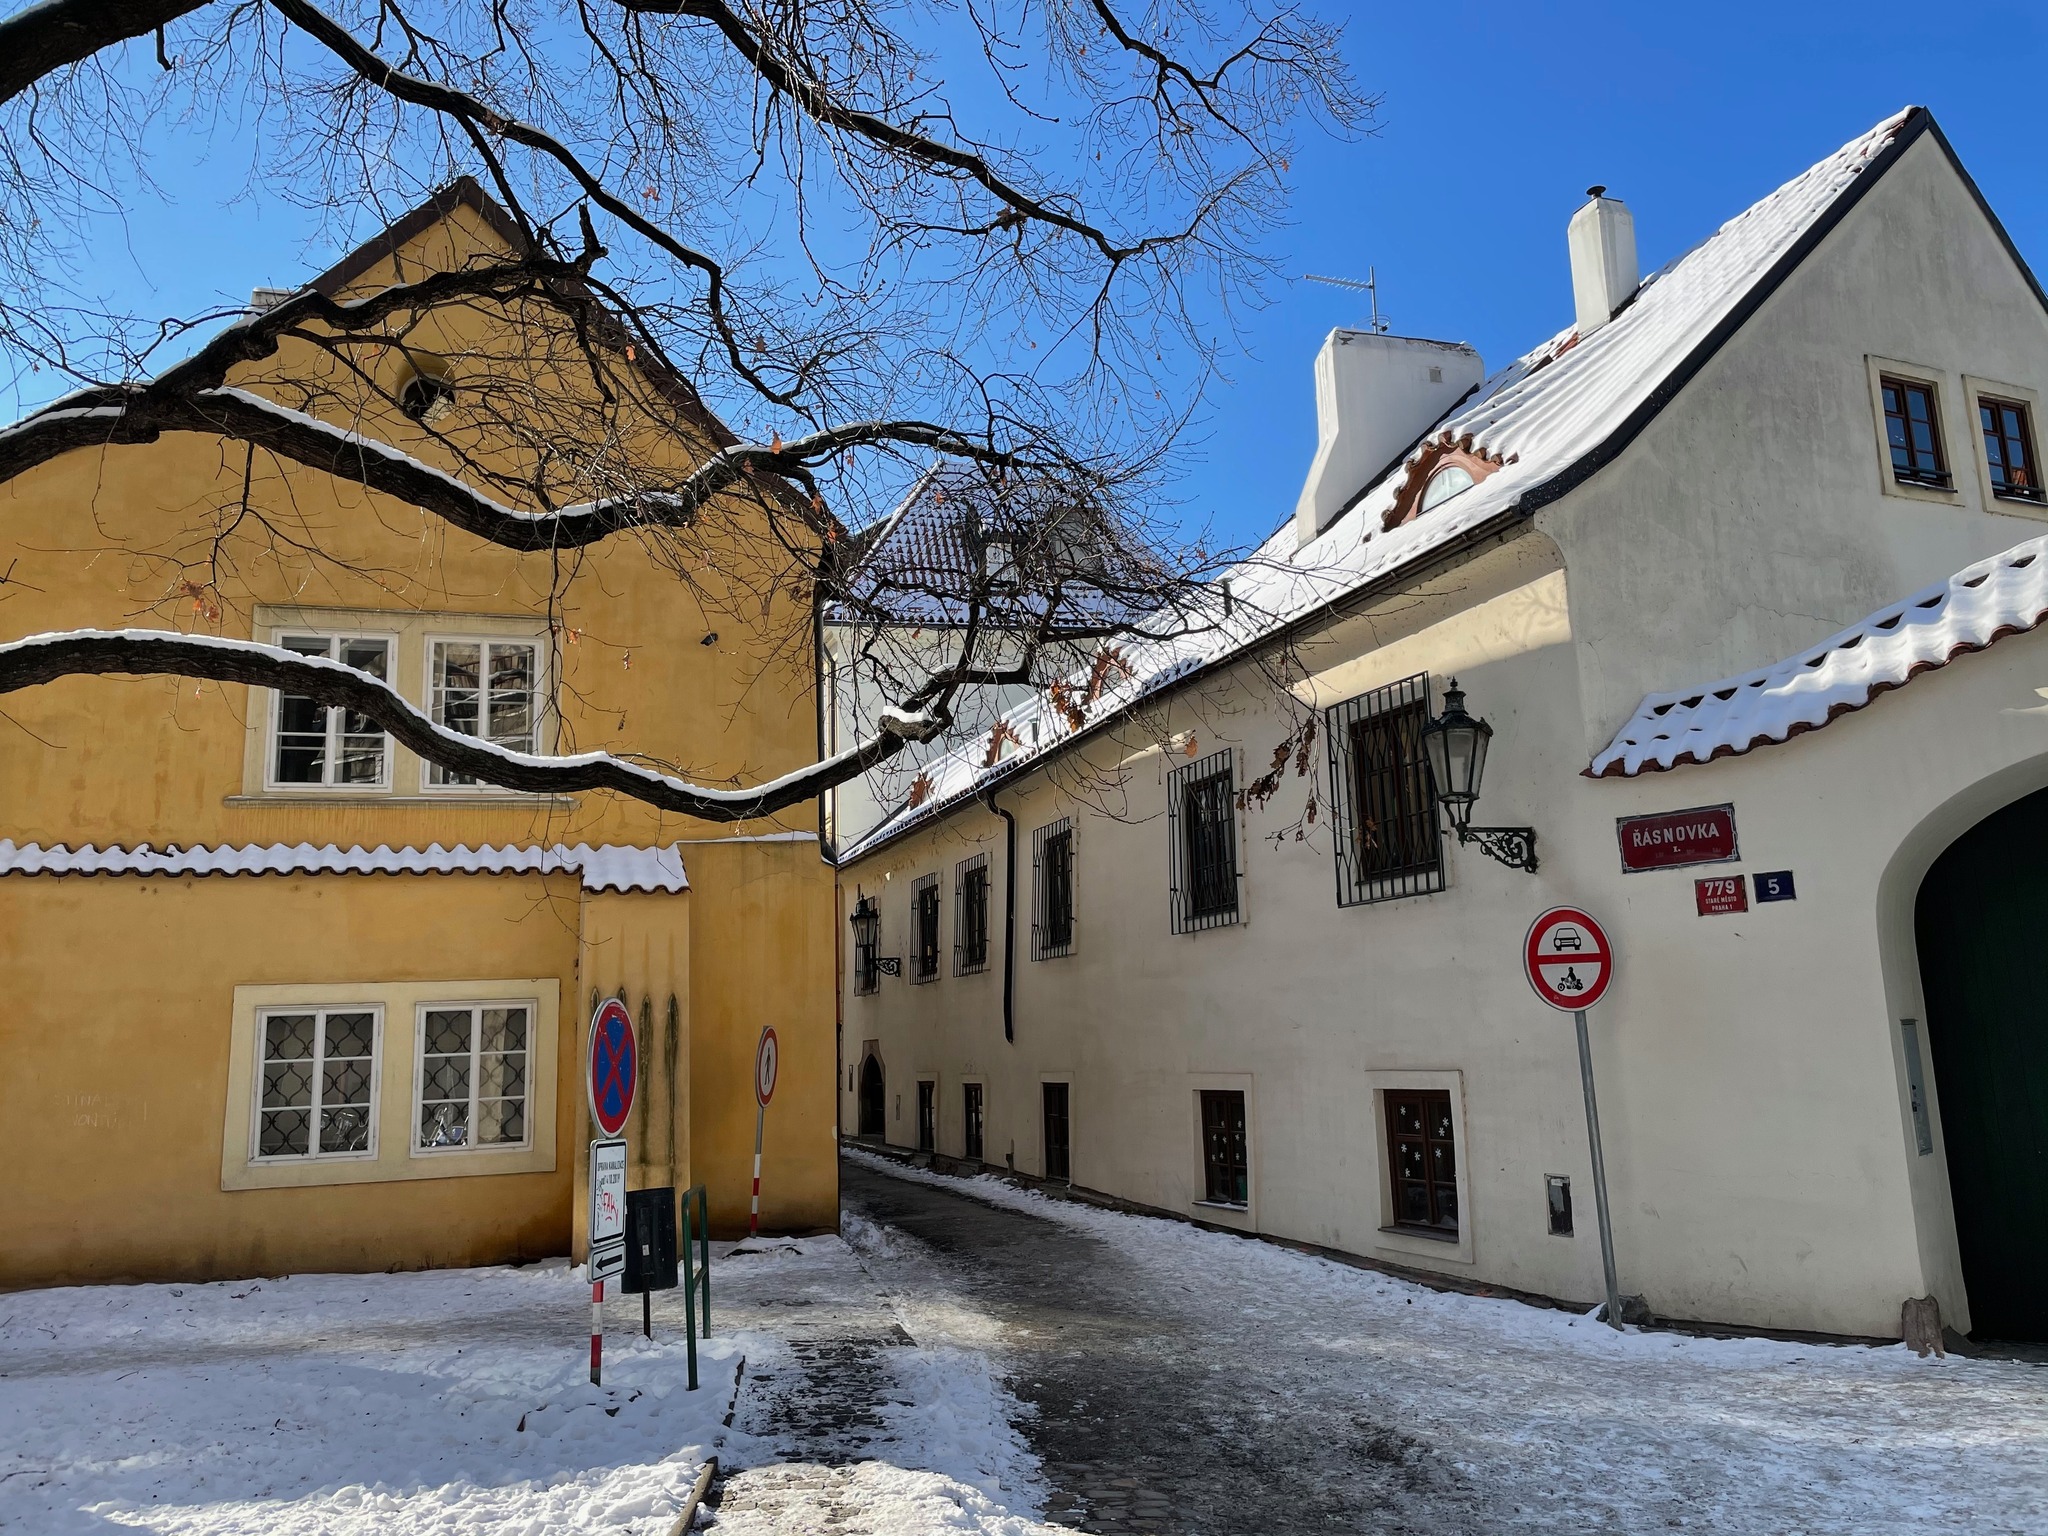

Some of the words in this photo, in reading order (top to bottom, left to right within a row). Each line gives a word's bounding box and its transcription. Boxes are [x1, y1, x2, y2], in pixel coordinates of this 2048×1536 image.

[1633, 823, 1719, 847] ŘÁSNOVKA
[1704, 880, 1735, 896] 779
[1767, 878, 1780, 895] 5
[1720, 895, 1737, 903] MĚSTO
